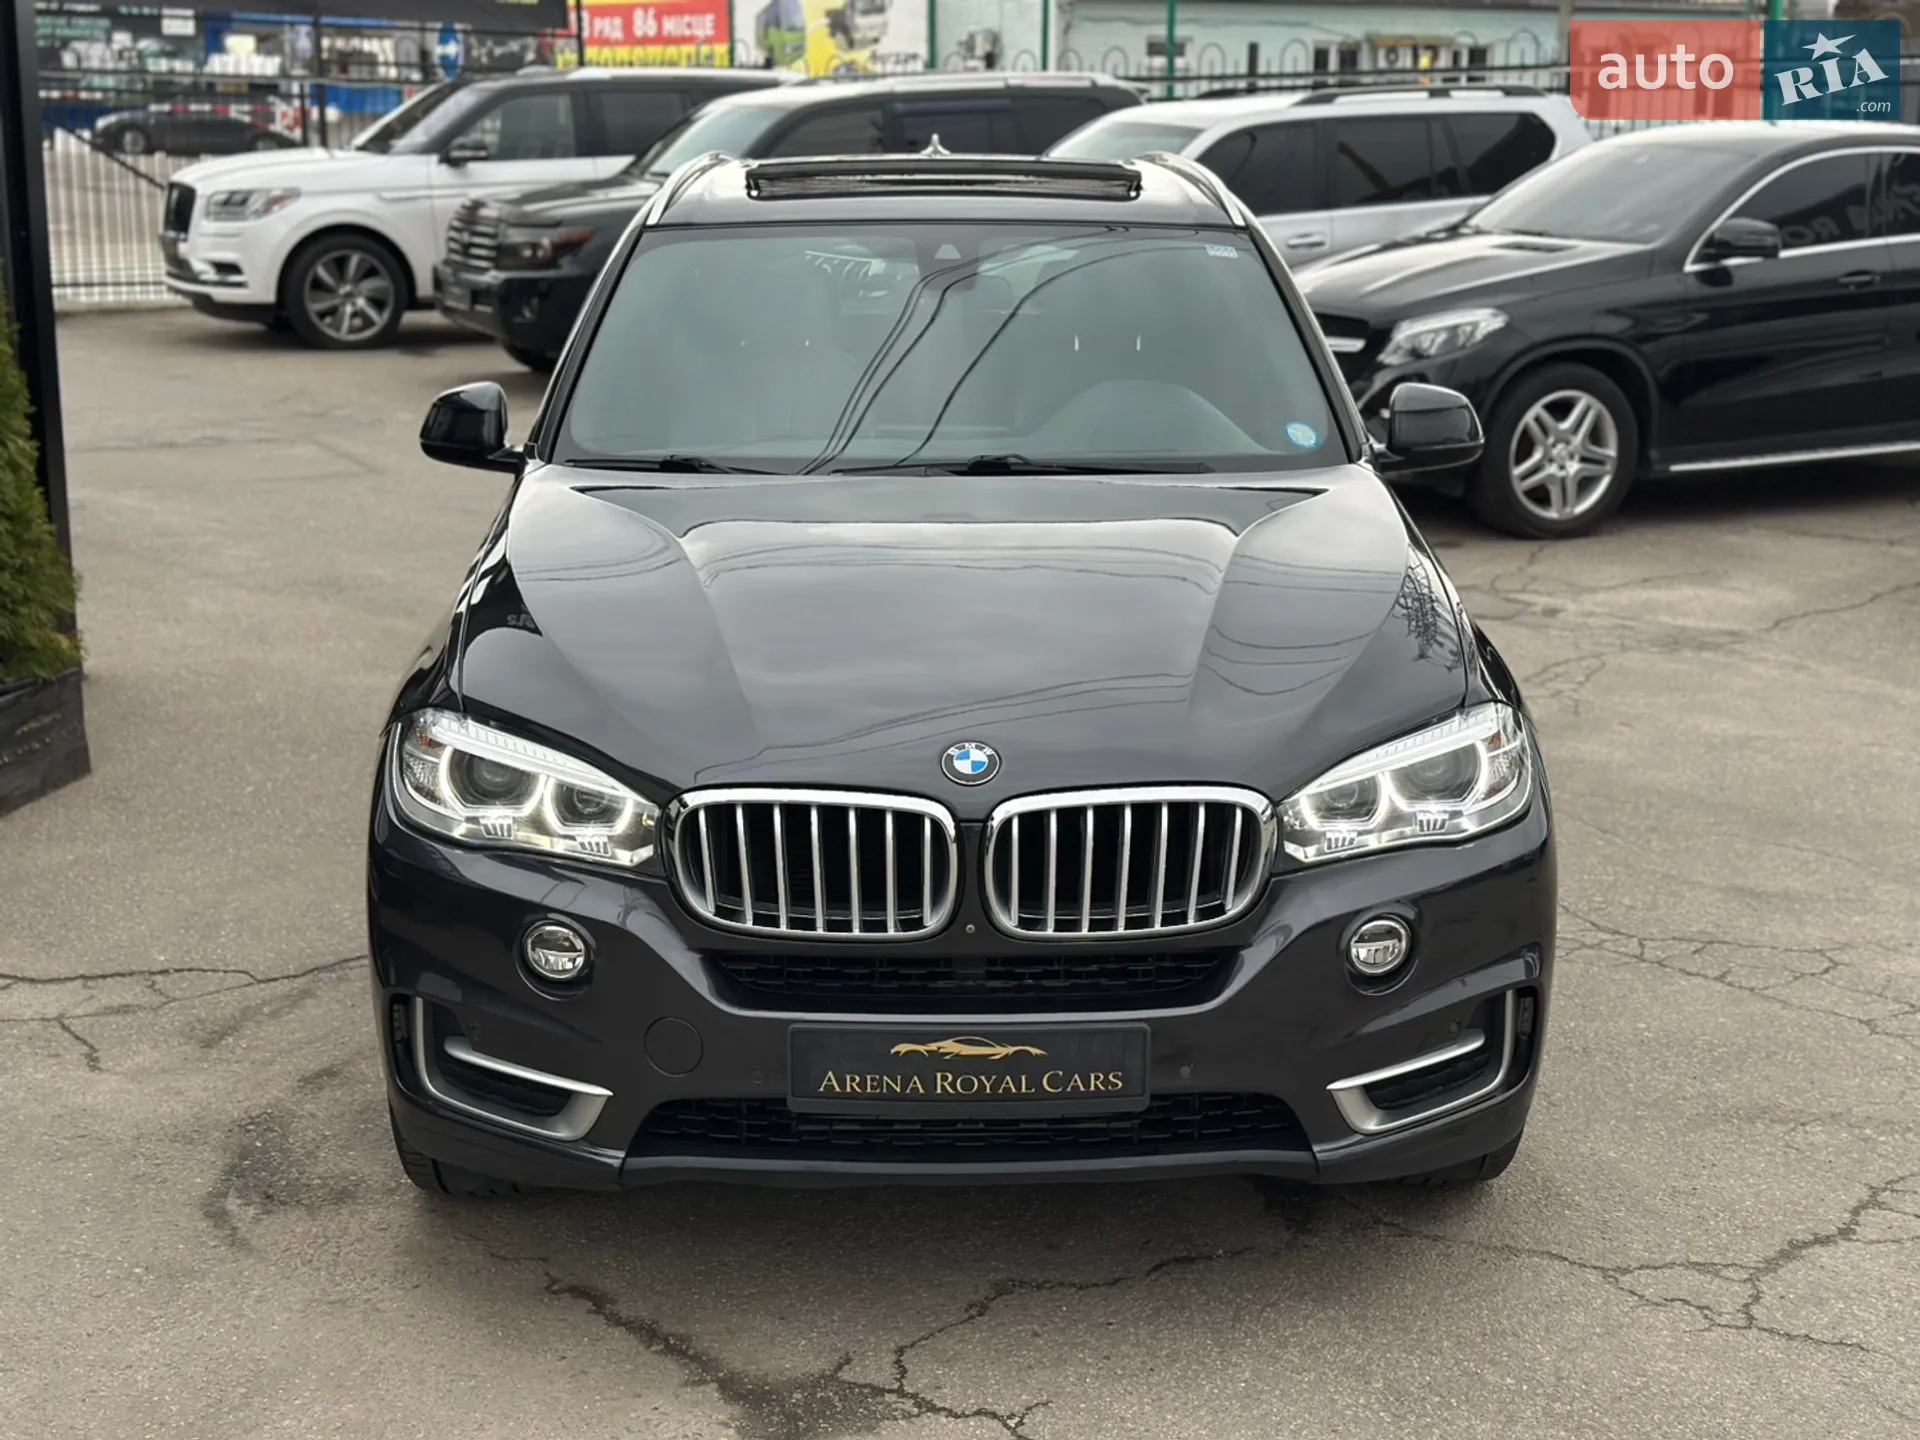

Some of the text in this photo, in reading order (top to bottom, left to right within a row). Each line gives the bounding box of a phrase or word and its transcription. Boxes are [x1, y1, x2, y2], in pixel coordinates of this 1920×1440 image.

[632, 7, 658, 38] 86
[818, 1070, 1124, 1095] ARENA ROYAL CARS
